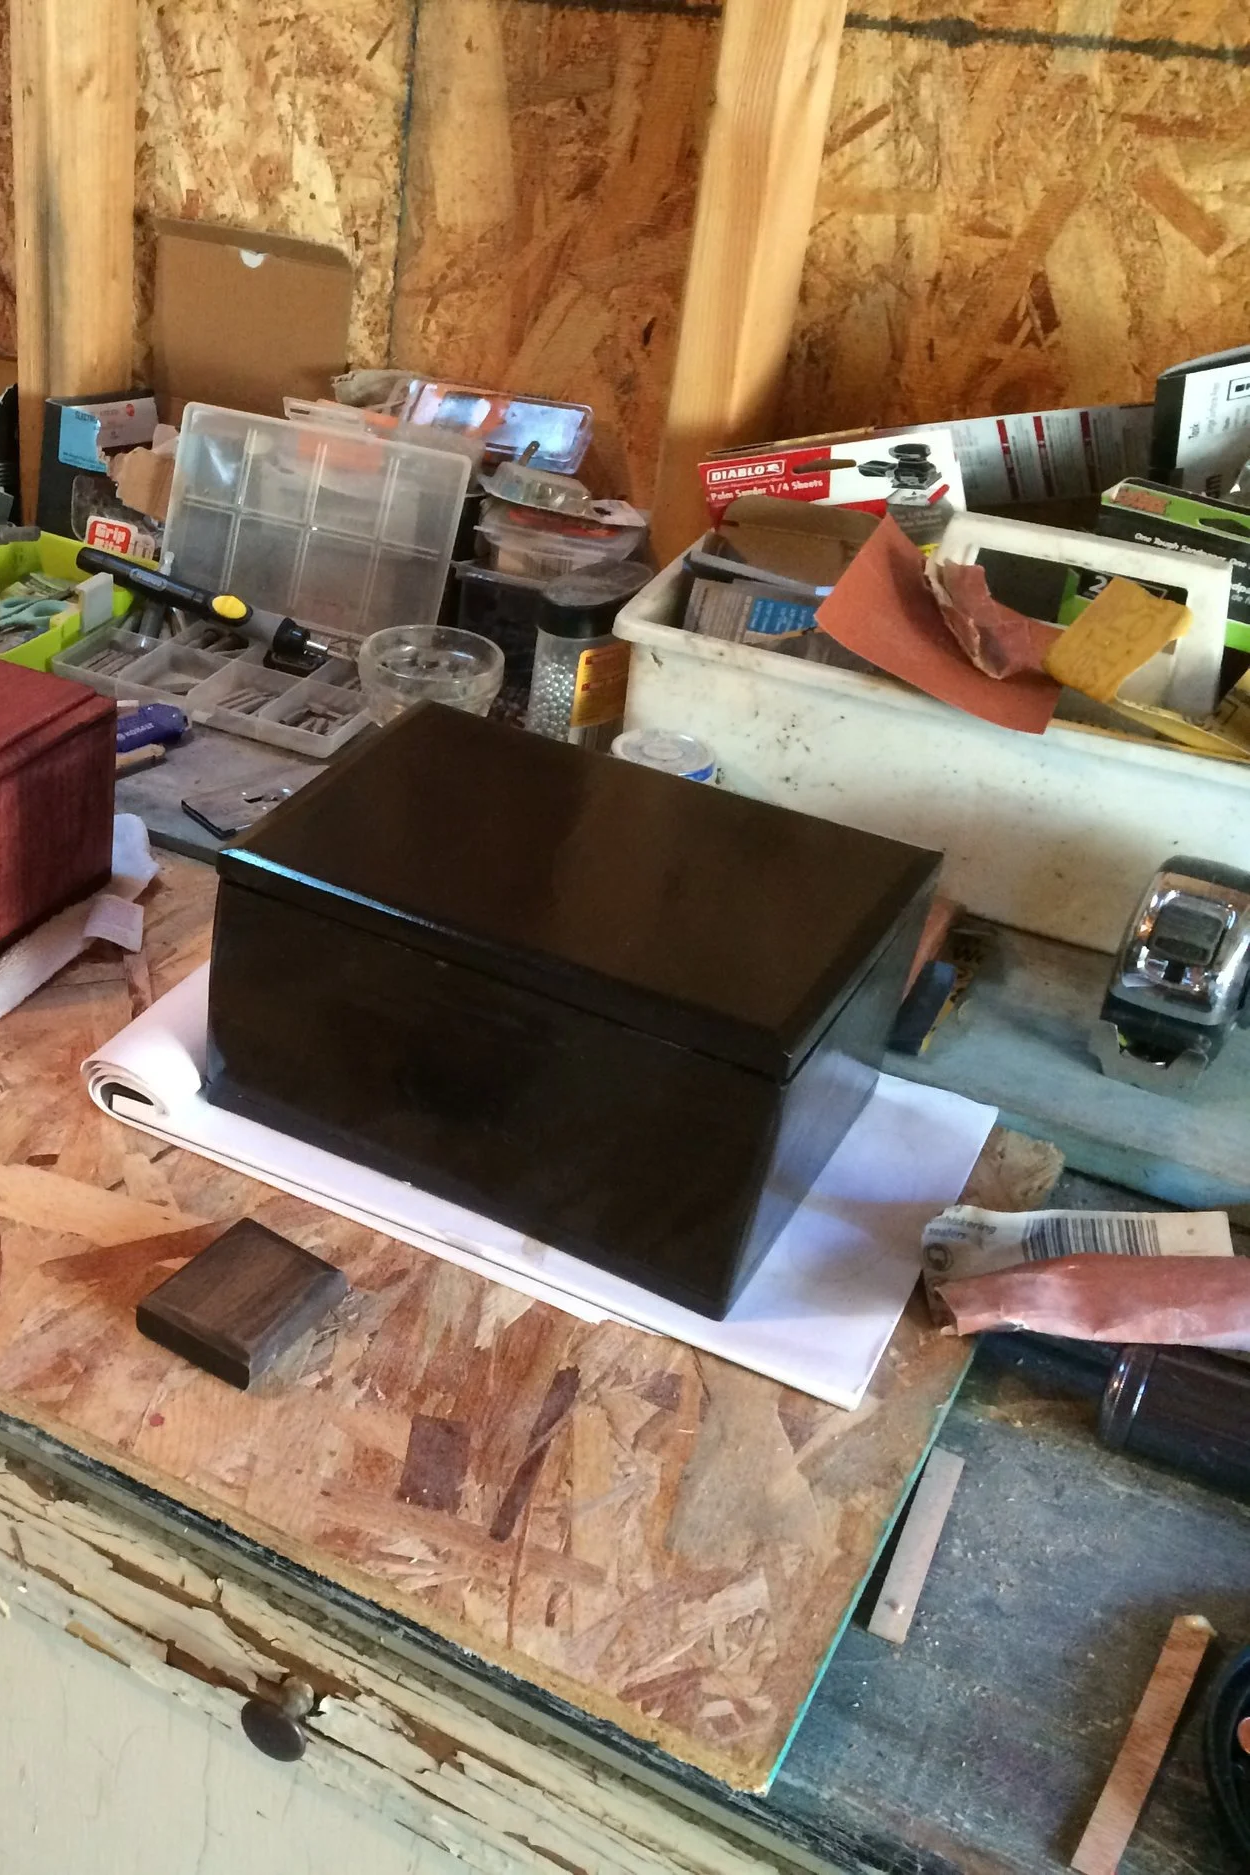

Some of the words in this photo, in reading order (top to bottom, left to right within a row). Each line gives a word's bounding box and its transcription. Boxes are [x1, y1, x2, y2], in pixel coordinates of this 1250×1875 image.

[711, 465, 766, 481] DIABLO
[710, 491, 734, 501] Palm
[736, 486, 767, 497] Sander
[769, 482, 790, 494] 1/4
[791, 479, 824, 490] Sheets
[94, 522, 127, 544] Grip
